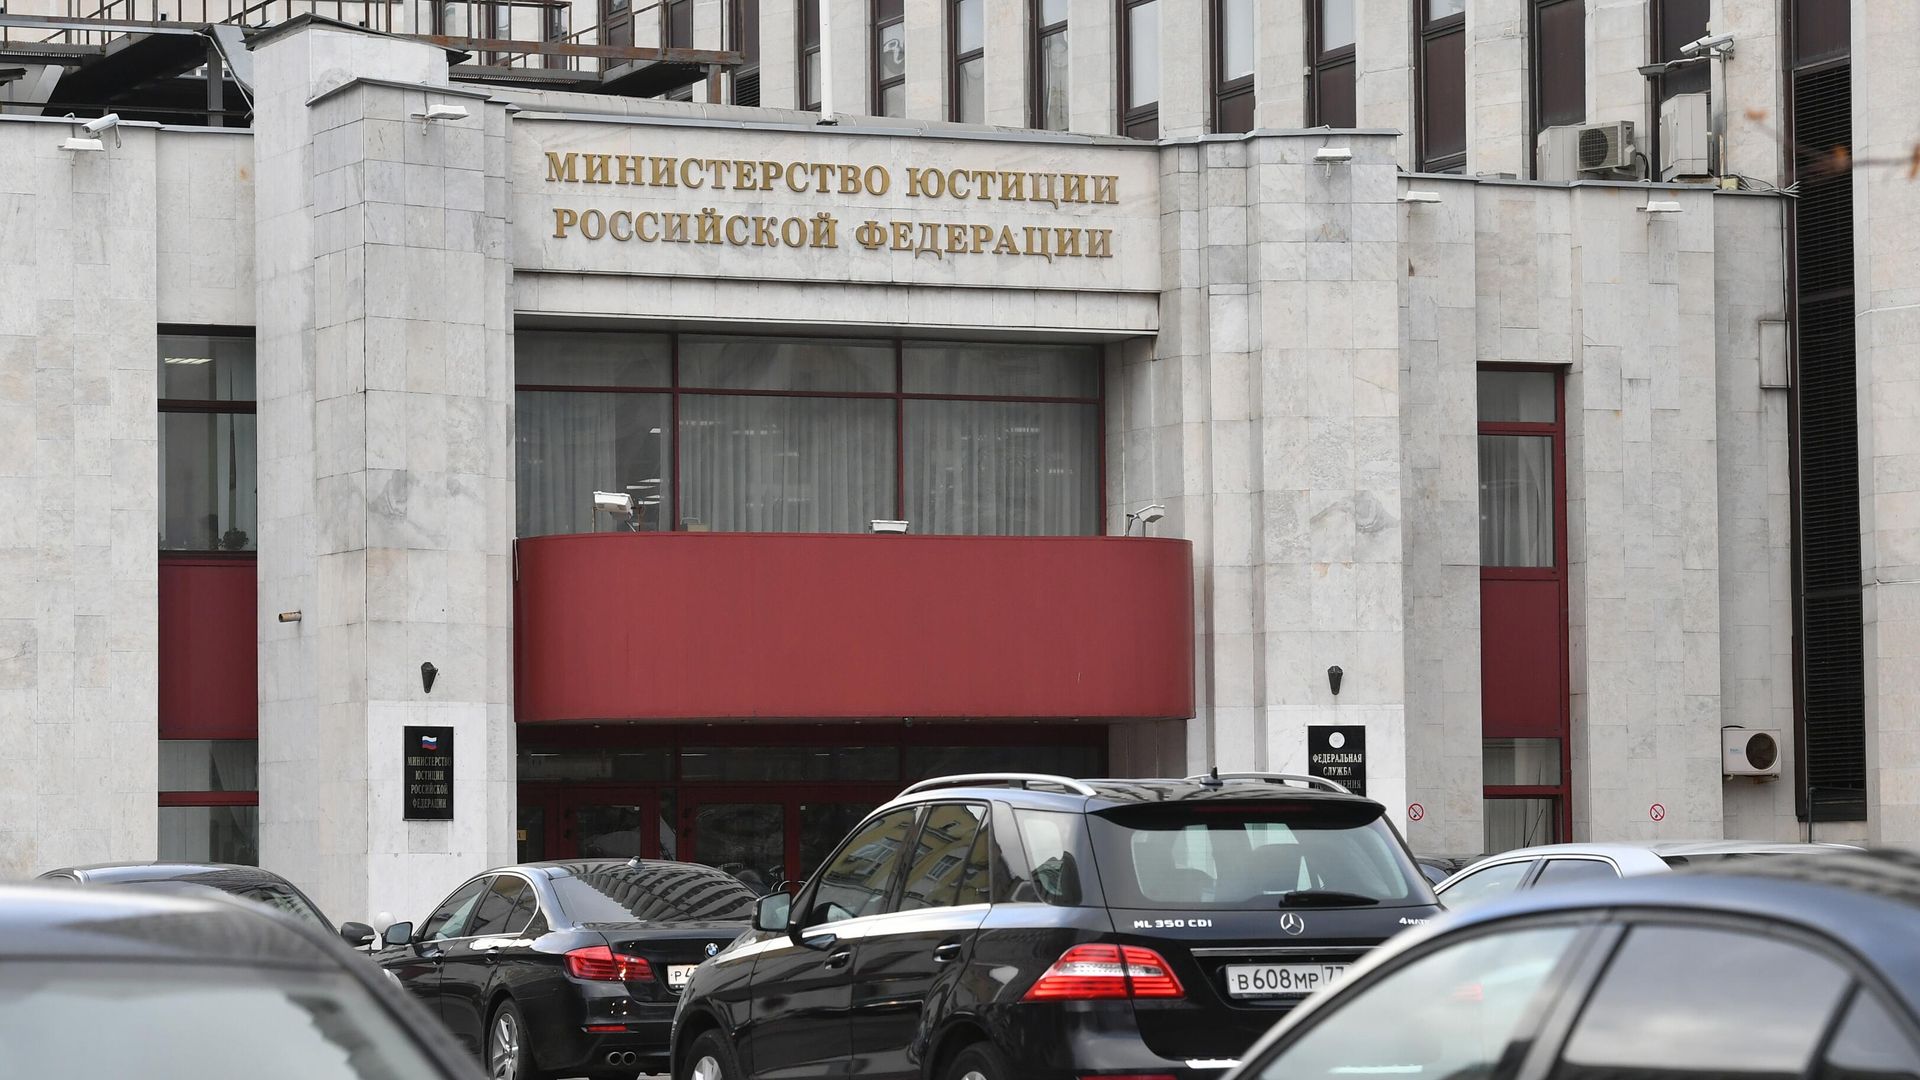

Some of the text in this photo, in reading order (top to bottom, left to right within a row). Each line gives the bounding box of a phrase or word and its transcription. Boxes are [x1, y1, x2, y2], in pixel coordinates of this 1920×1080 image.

[545, 151, 1119, 209] МИНИСТЕРСТВО ЮСТИЦИИ
[552, 207, 1113, 264] РОССИЙСКОЙ ФЕДЕРАЦИИ
[407, 756, 452, 767] МИНИСТЕРСТВО
[1312, 753, 1362, 764] ФЕДЕРАЛЬНАЯ
[415, 770, 444, 780] ЮСТИЦИИ
[1322, 766, 1352, 776] СЛУЖБА
[410, 782, 448, 794] РОССИЙСКОЙ
[412, 798, 447, 809] ФЕДЕРАЦИИ
[1133, 919, 1212, 928] ML 350 CDI
